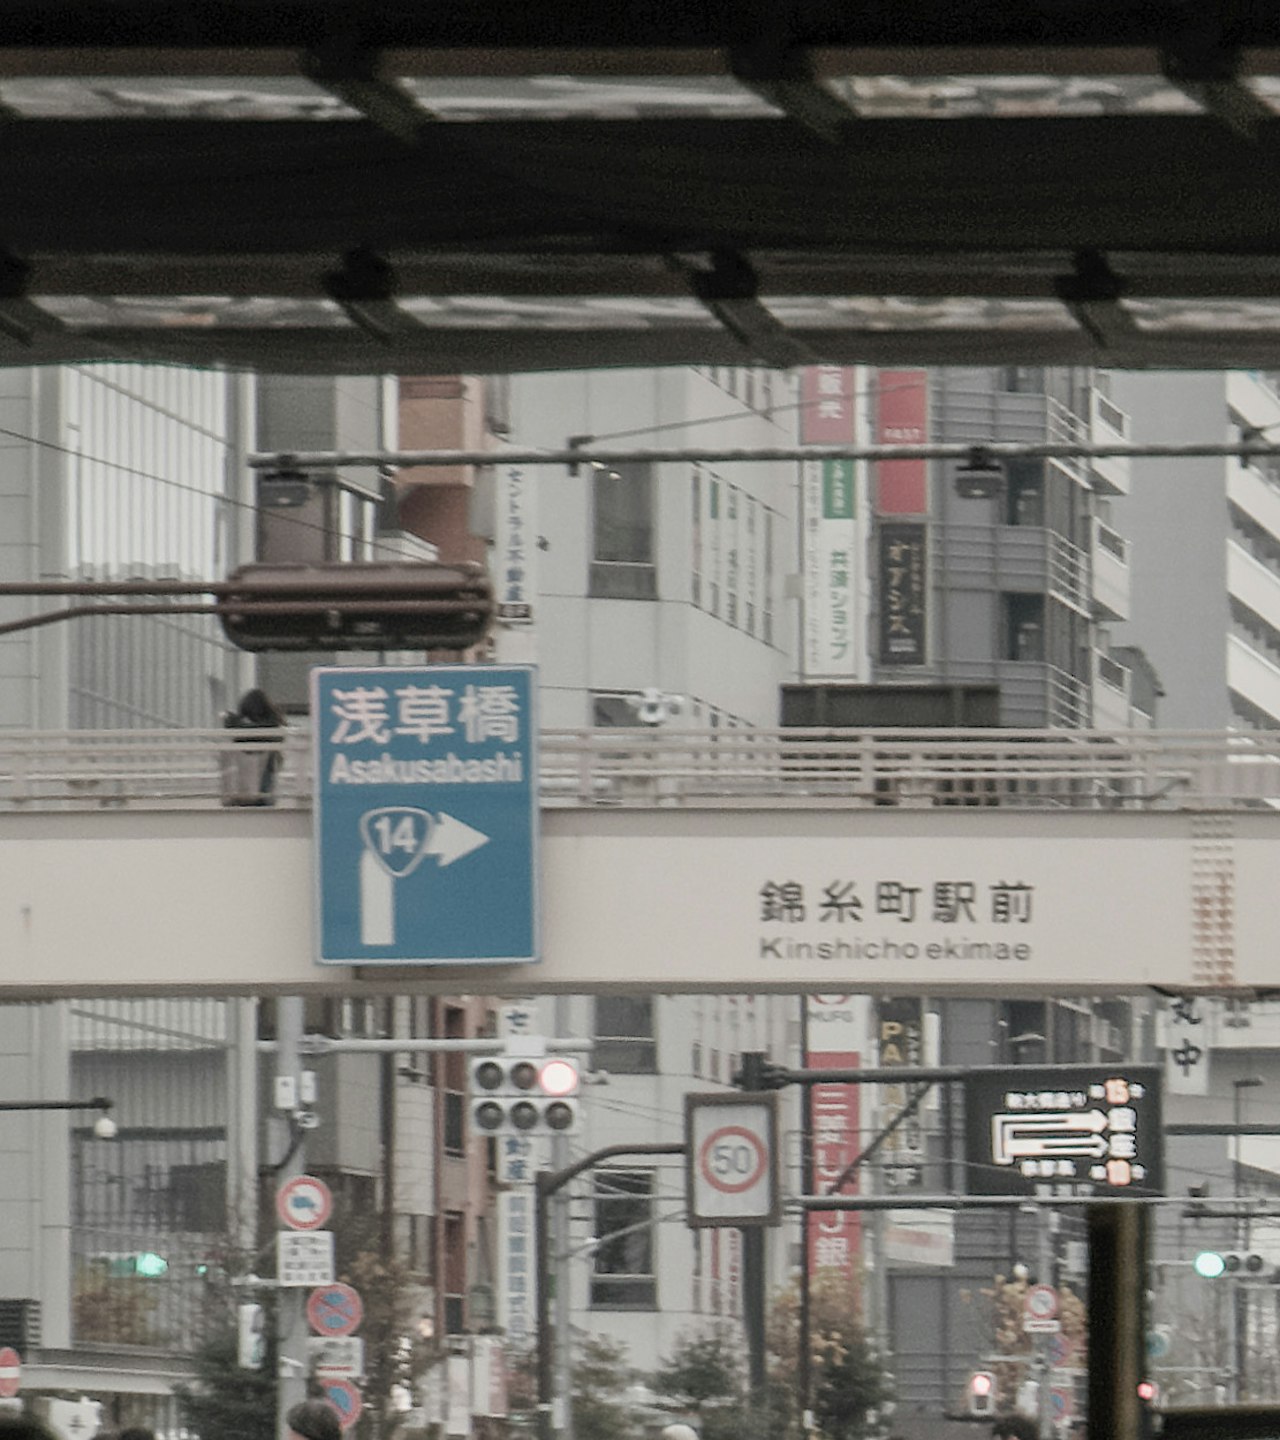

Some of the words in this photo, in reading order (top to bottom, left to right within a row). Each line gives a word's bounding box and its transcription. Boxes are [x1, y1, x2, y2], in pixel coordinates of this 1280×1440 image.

[330, 684, 520, 744] 浅草橋
[329, 751, 523, 785] Asakusabashi
[374, 815, 419, 855] 14
[759, 879, 1034, 923] 錦糸町駅前
[714, 1144, 749, 1175] 50
